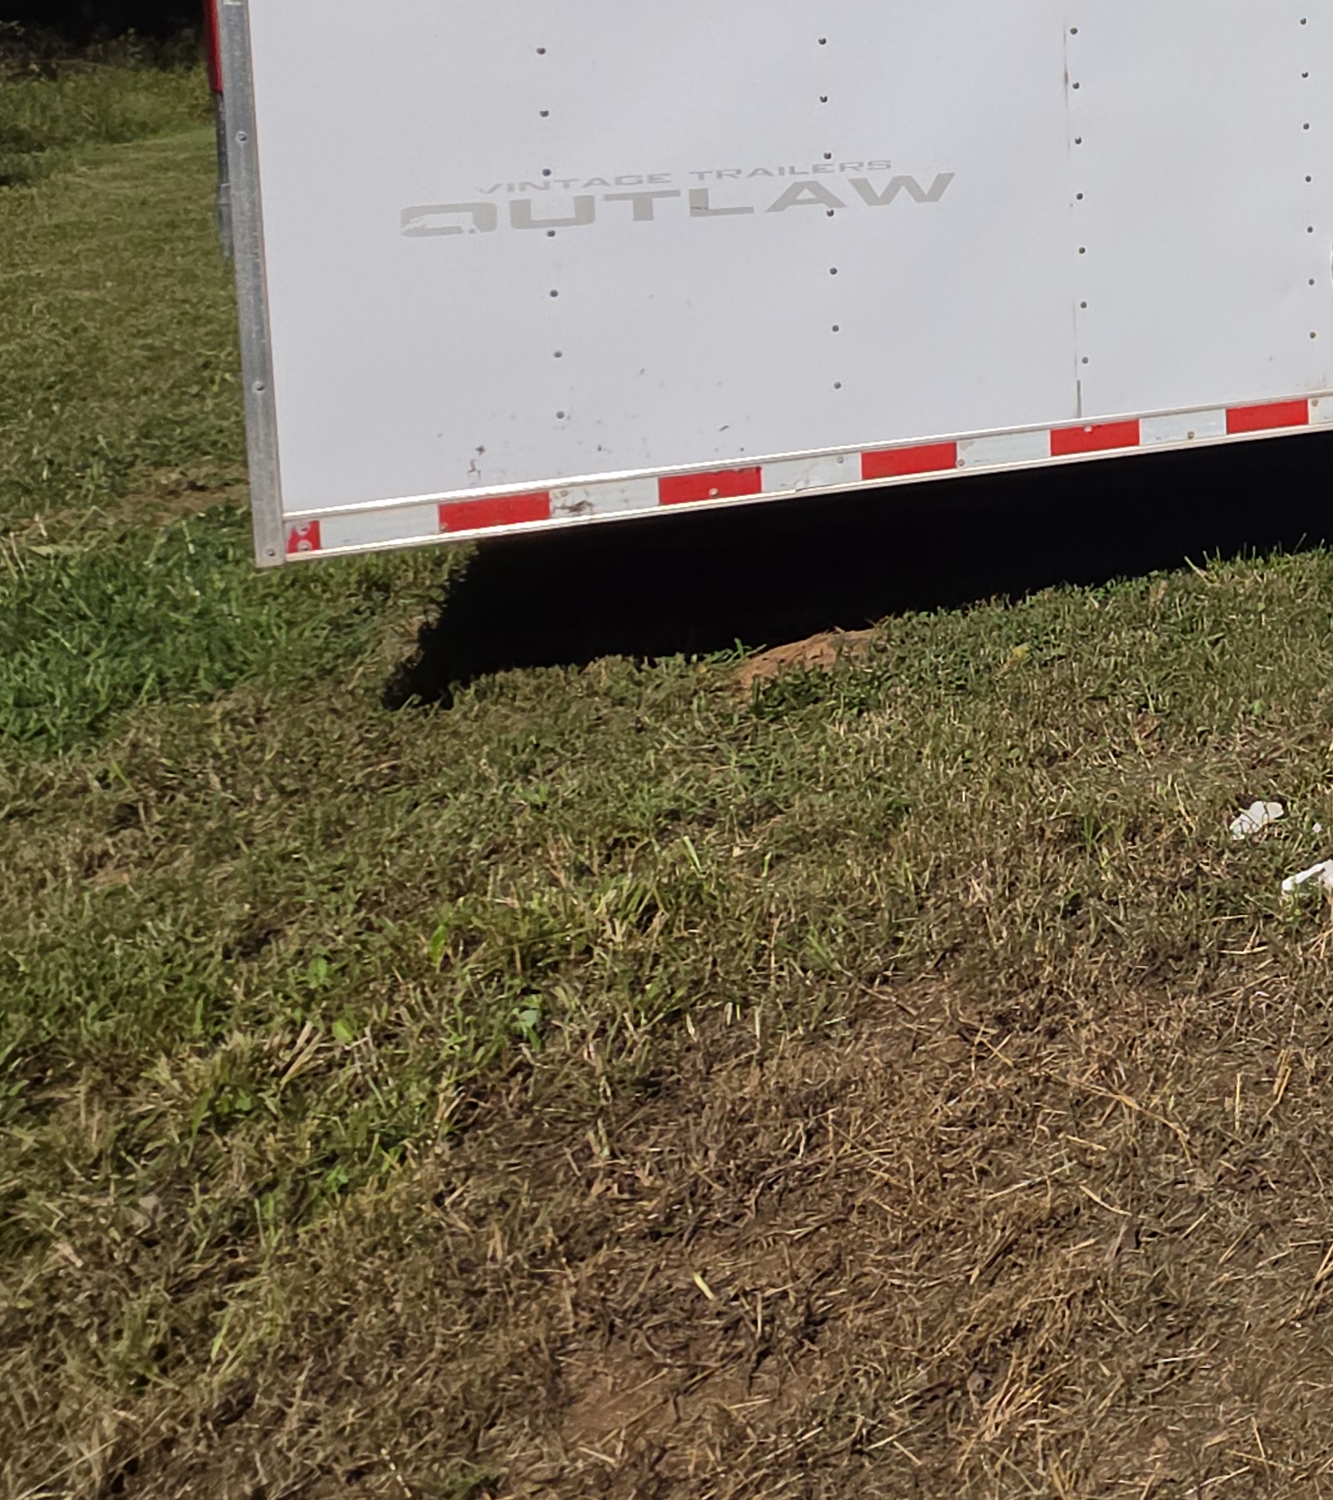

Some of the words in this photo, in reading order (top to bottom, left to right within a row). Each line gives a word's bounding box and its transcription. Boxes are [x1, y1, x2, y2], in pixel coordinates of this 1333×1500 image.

[475, 172, 672, 195] VINTAGE
[688, 159, 892, 182] TRAILERS
[400, 172, 955, 238] OUTLAW
